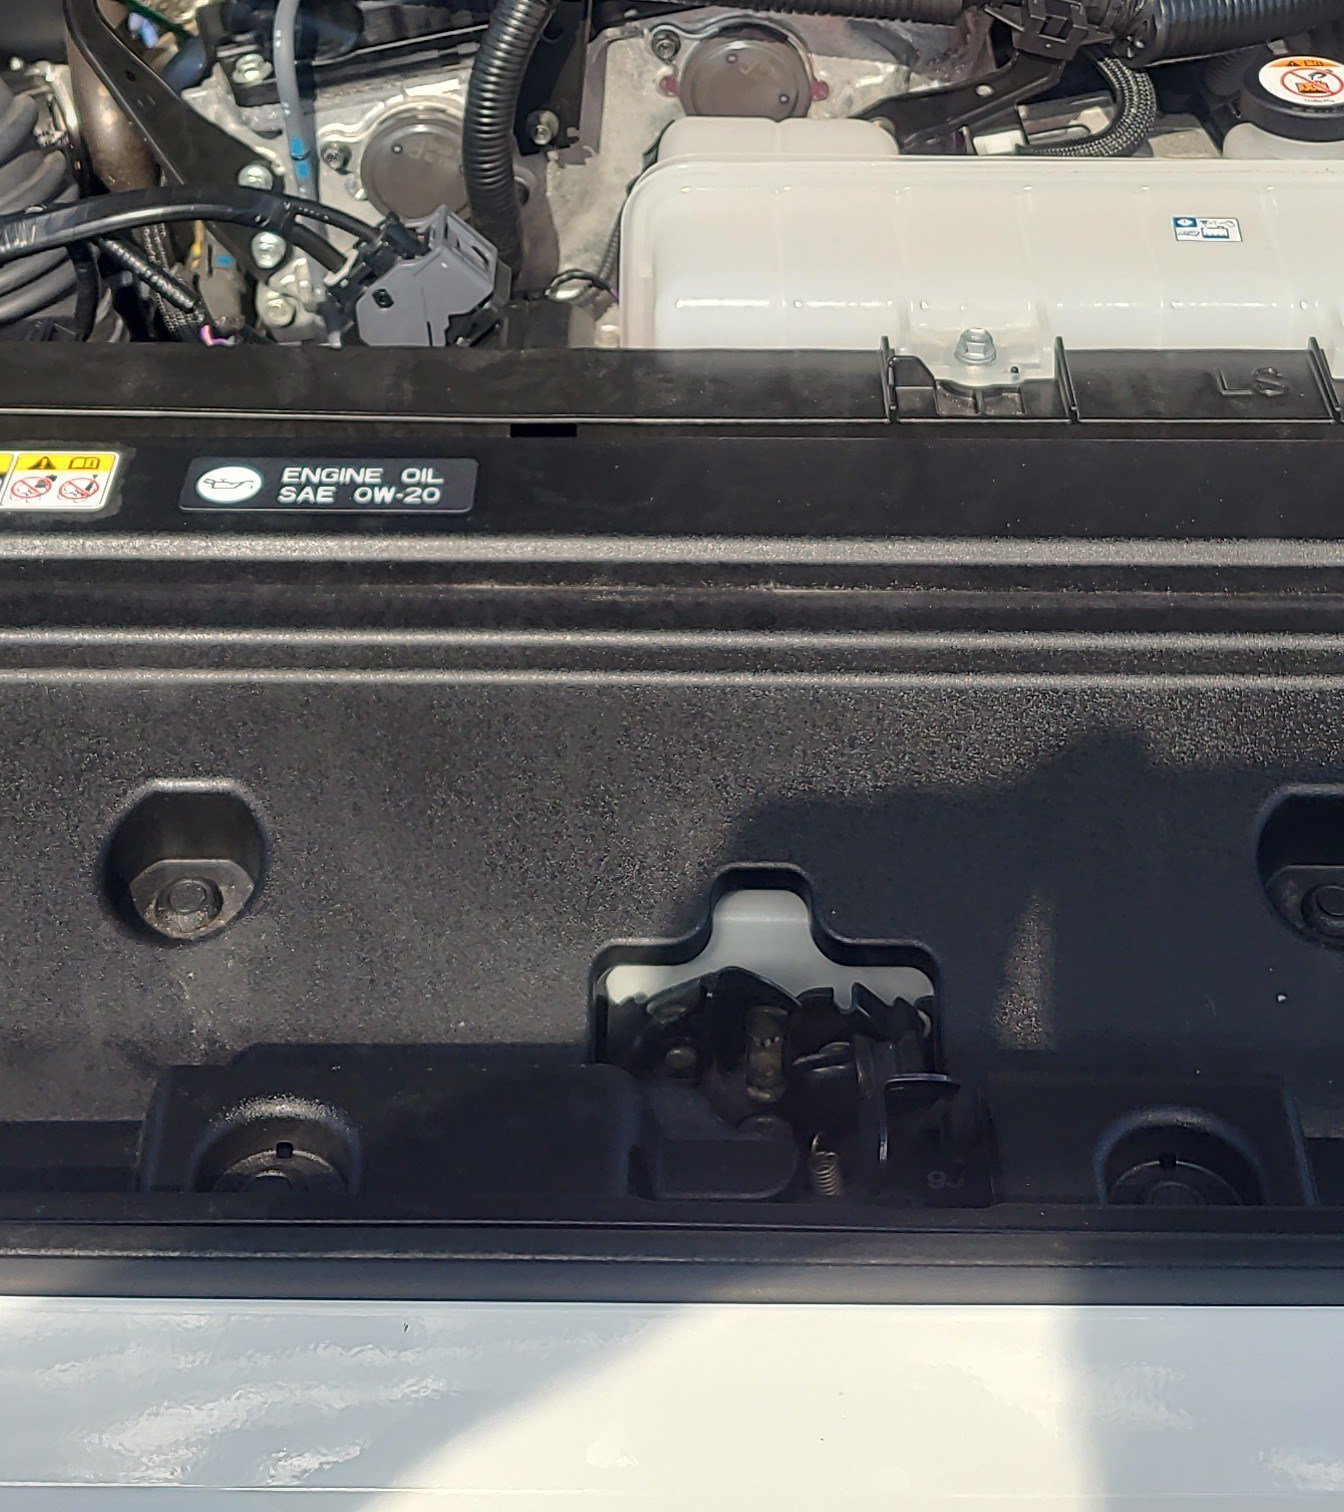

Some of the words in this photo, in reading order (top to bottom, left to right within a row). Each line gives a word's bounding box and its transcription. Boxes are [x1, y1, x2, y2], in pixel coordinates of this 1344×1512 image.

[281, 467, 384, 485] ENGINE
[401, 467, 444, 484] OIL
[278, 486, 336, 504] SAE
[353, 487, 441, 504] 0W-20
